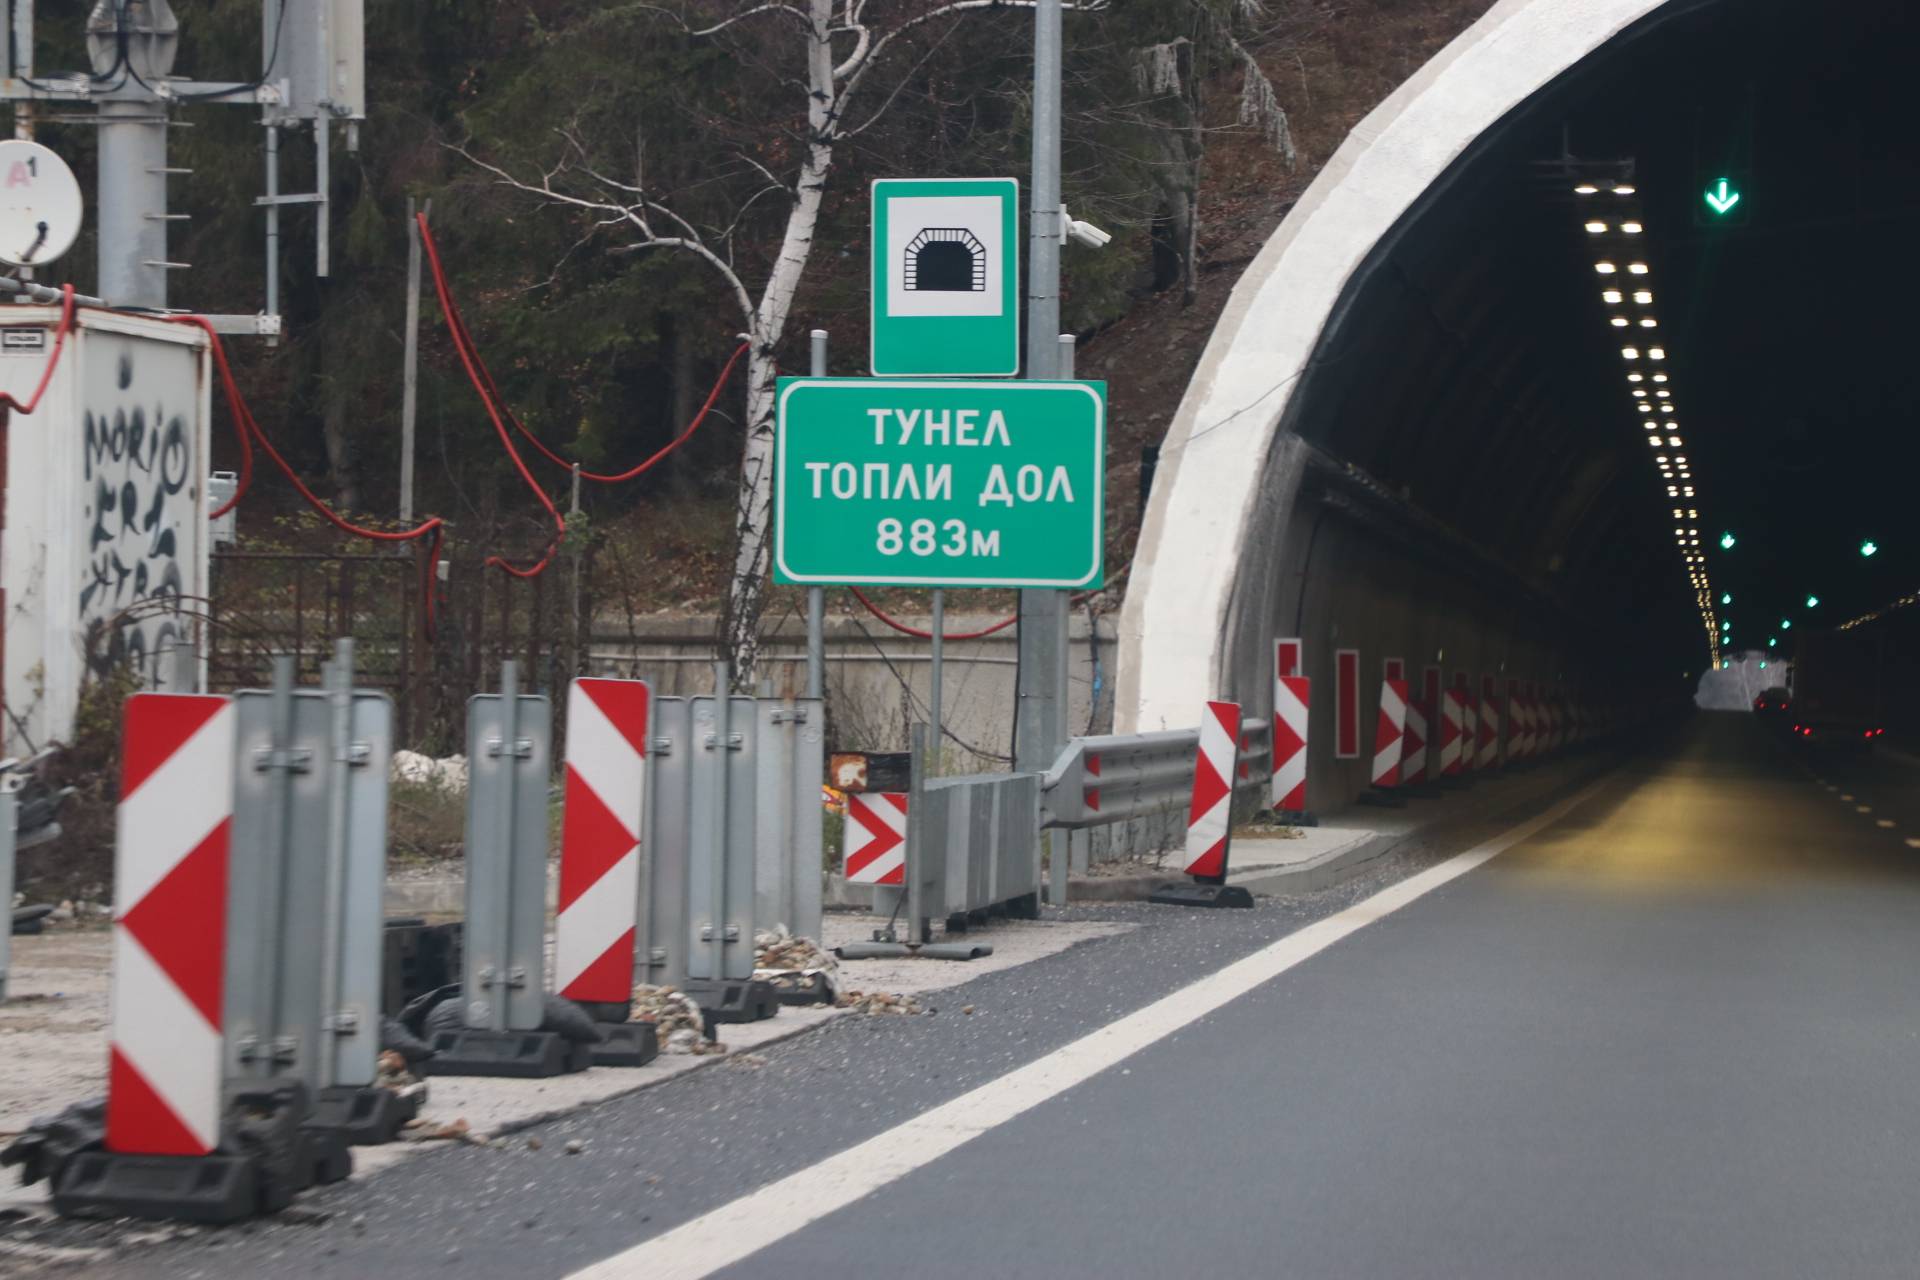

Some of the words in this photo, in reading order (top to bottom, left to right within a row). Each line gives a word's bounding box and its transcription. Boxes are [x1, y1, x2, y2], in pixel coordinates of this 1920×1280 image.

[867, 408, 1011, 446] ТУНЕЛ
[805, 462, 952, 500] ТОПЛИ
[979, 464, 1074, 507] ДОЛ
[876, 518, 1000, 557] 883м
